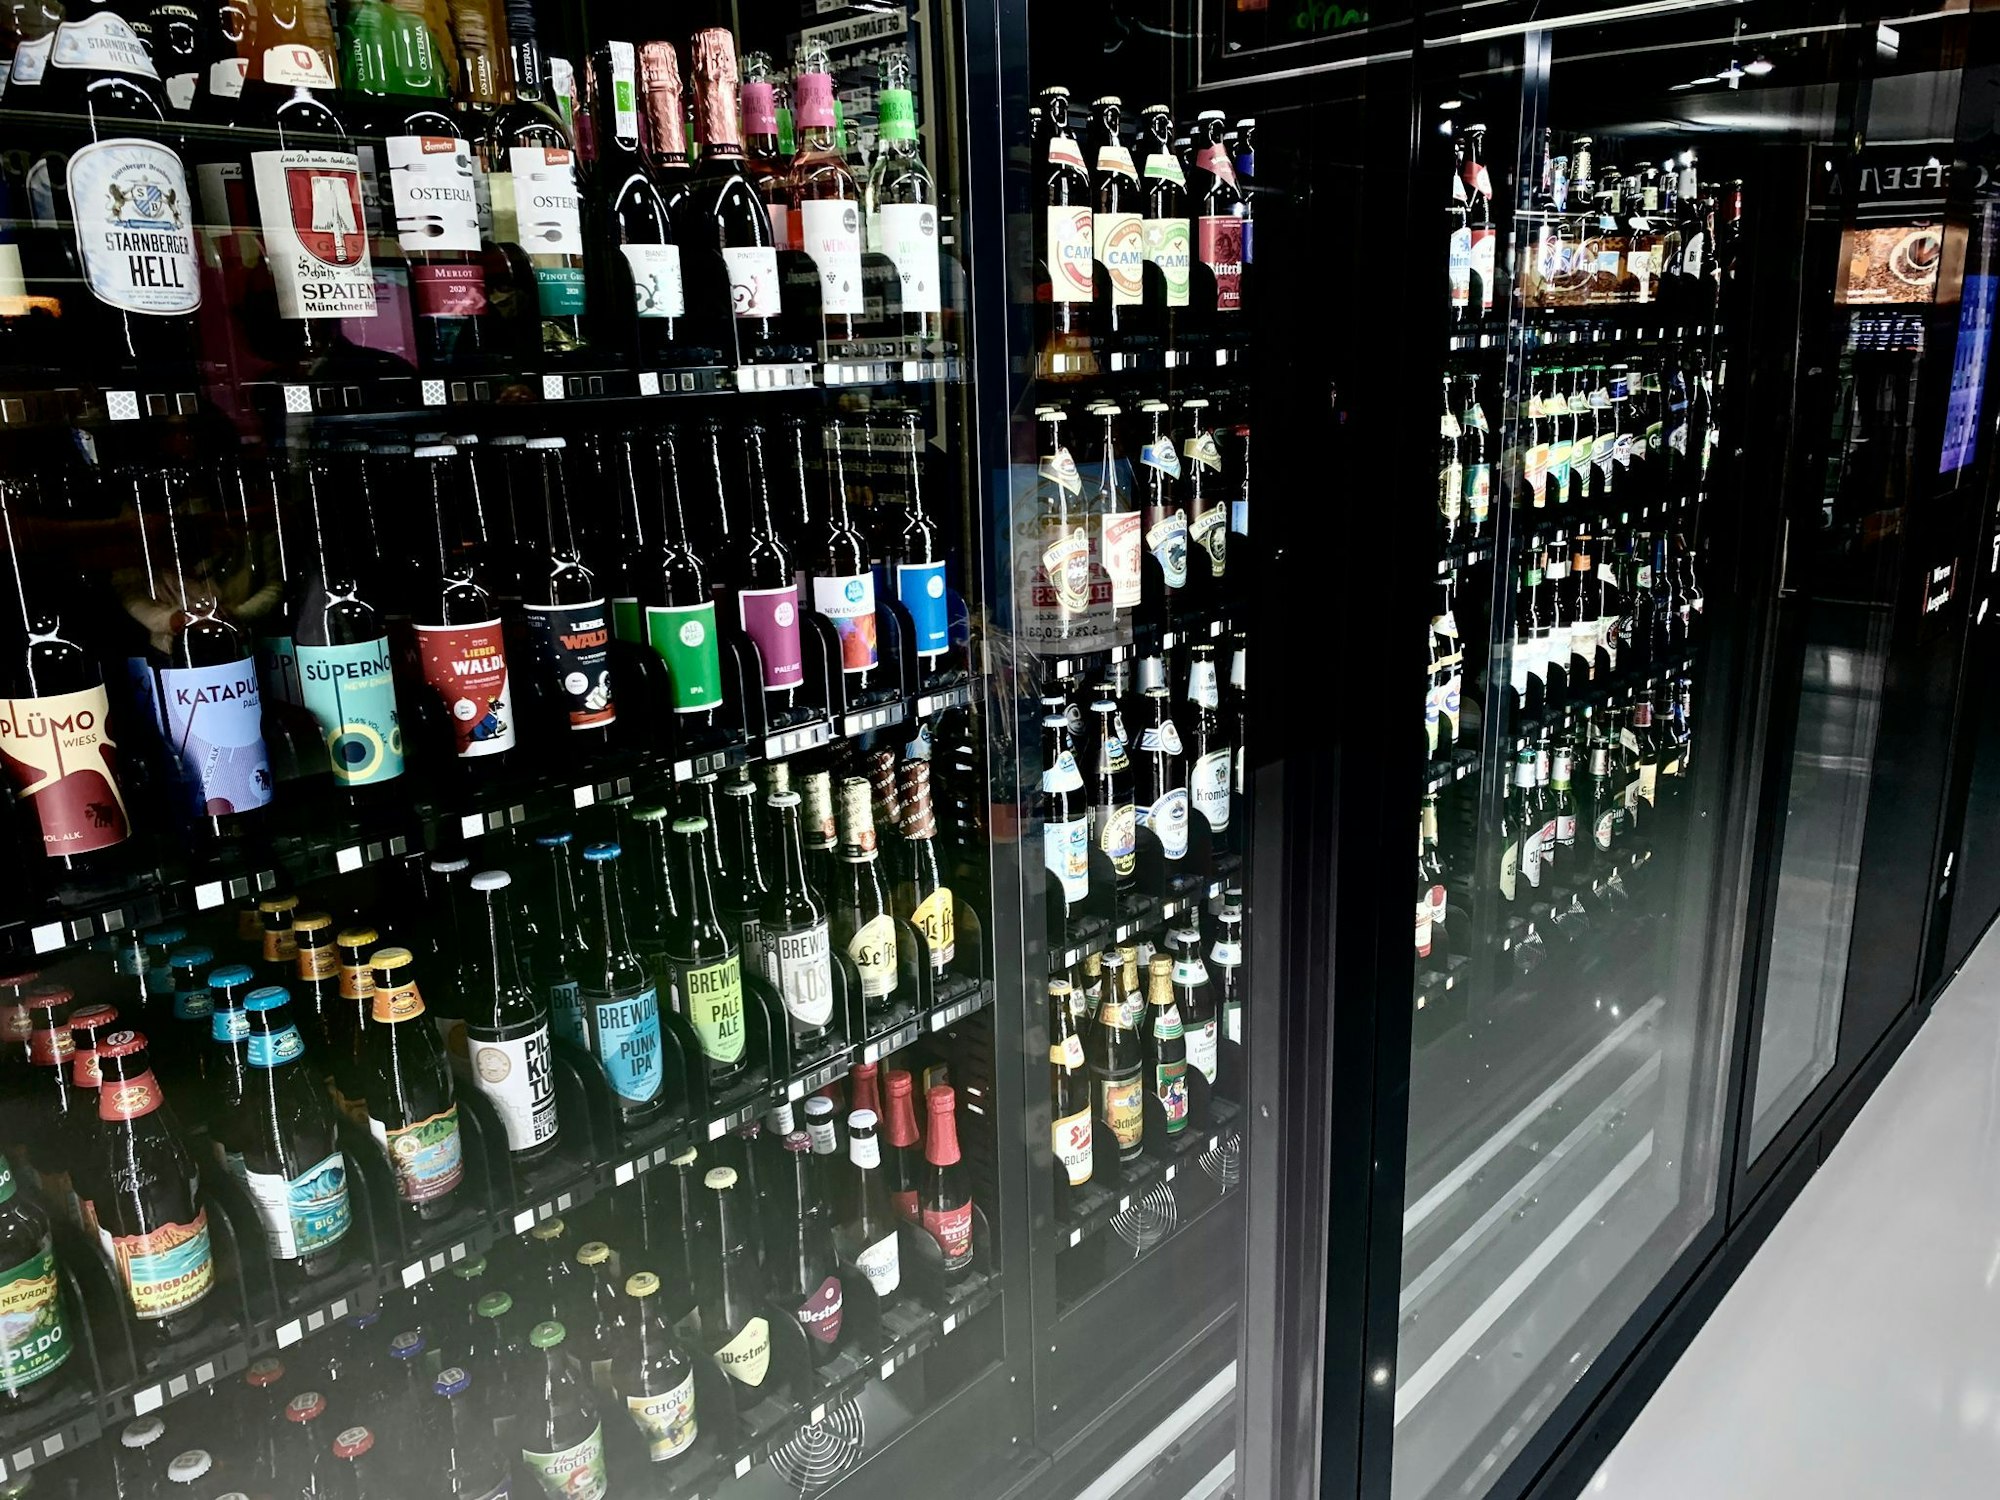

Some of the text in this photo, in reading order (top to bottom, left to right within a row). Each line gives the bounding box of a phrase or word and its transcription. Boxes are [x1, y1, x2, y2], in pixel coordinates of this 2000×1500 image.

[415, 25, 427, 71] OSTERIA
[109, 51, 139, 66] HELL
[522, 42, 534, 84] OSTERIA
[424, 141, 453, 151] demeter
[410, 187, 472, 202] OSTERIA
[105, 233, 190, 255] STARNBERGER
[129, 255, 184, 288] HELL
[435, 268, 473, 278] MERLOT
[539, 271, 567, 281] PINOT
[302, 283, 375, 300] SPATEN
[449, 285, 467, 293] 2020
[305, 302, 363, 312] Münchner
[824, 607, 841, 615] NEW
[464, 646, 496, 658] LIEBER
[690, 686, 704, 694] IPA
[0, 699, 95, 740] PLÜMO
[63, 733, 98, 749] WIESS
[63, 831, 84, 842] ALK.
[711, 996, 740, 1022] PALE
[718, 1018, 740, 1039] ALE
[620, 1033, 656, 1060] PUNK
[631, 1056, 652, 1077] IPA
[314, 1213, 334, 1231] BIG
[136, 1261, 210, 1297] LONGBOARD
[1, 1286, 50, 1309] NEVADA
[30, 1352, 51, 1370] IPA
